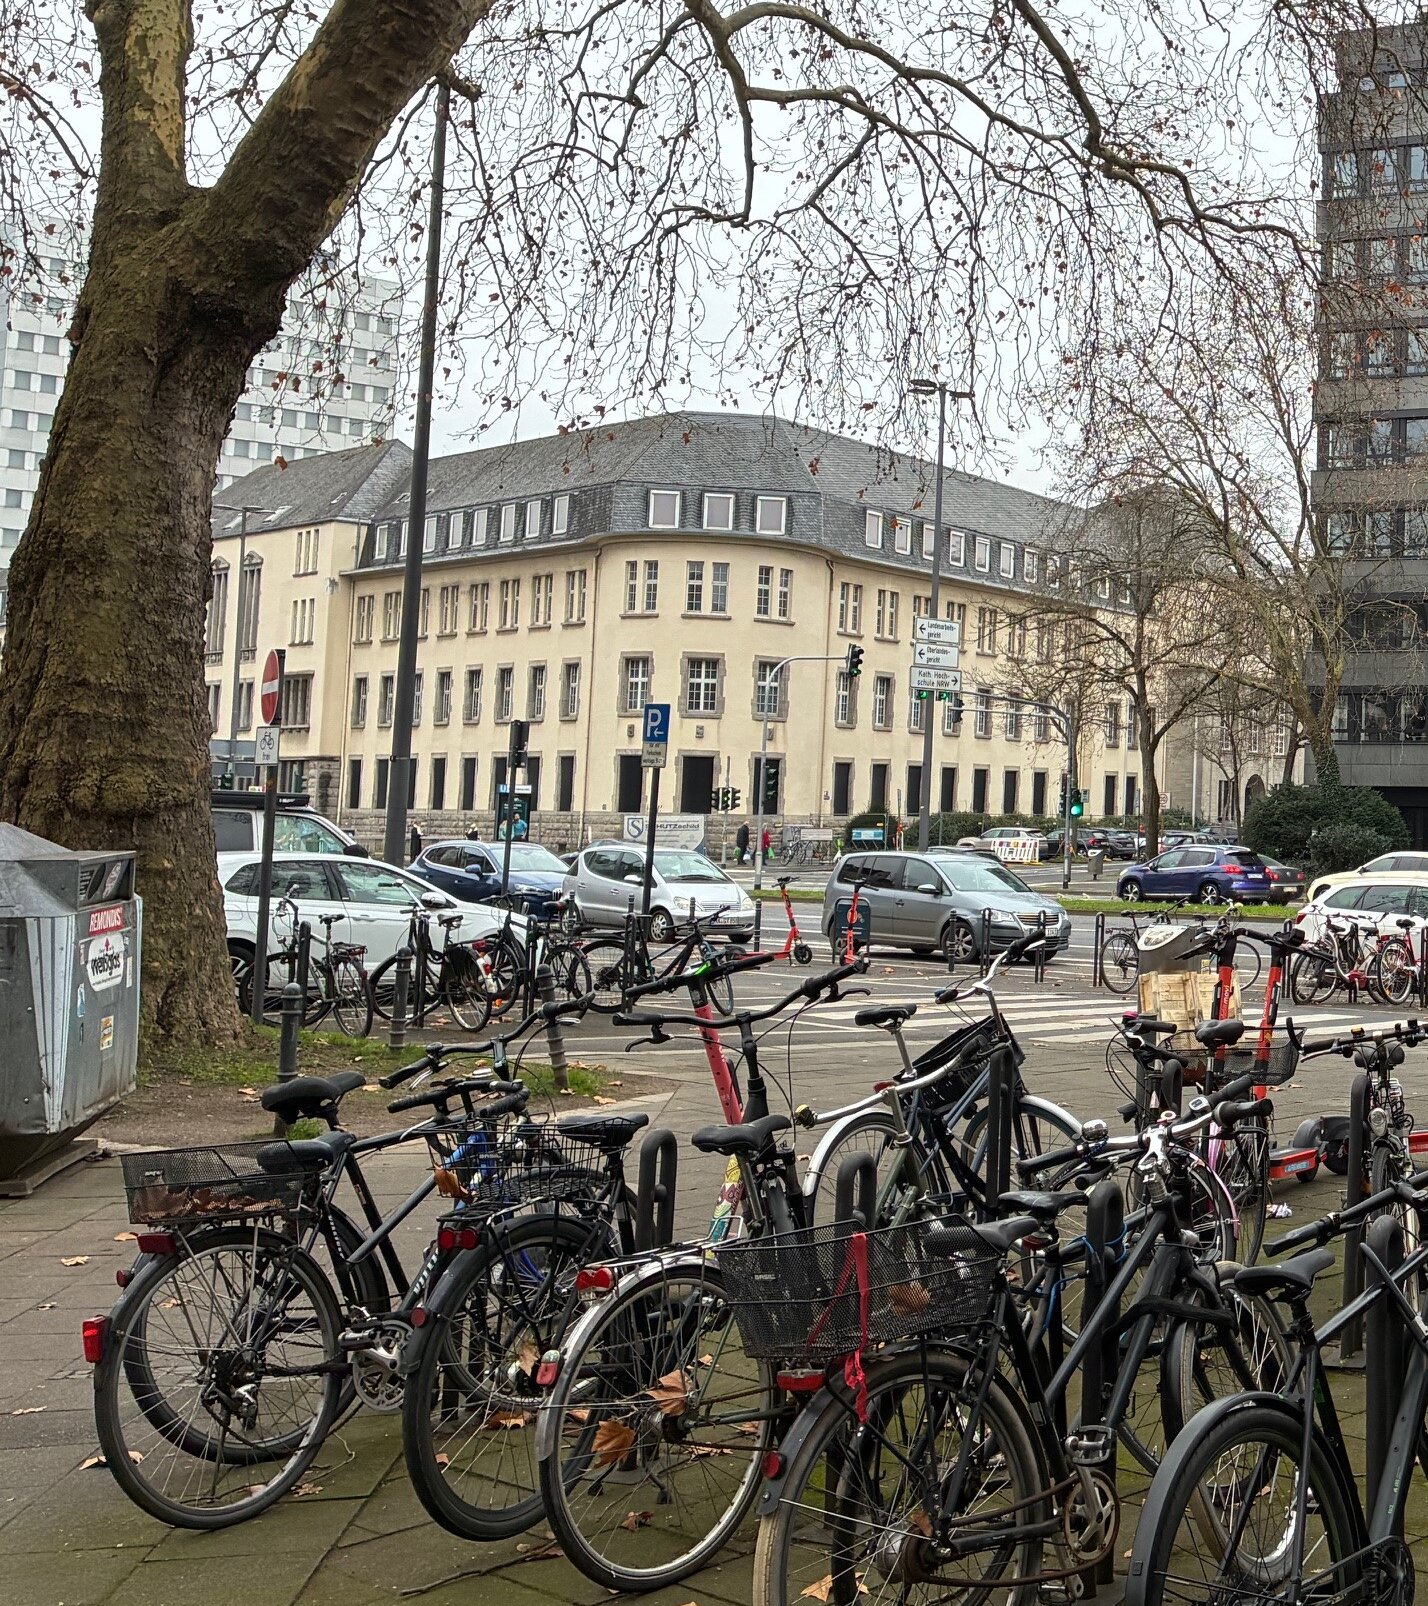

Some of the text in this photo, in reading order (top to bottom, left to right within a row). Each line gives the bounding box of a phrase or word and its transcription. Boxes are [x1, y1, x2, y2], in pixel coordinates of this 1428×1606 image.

[934, 671, 950, 679] Hoch-
[917, 679, 950, 688] schule NRW
[646, 708, 662, 738] P
[89, 908, 121, 932] REMONDIS
